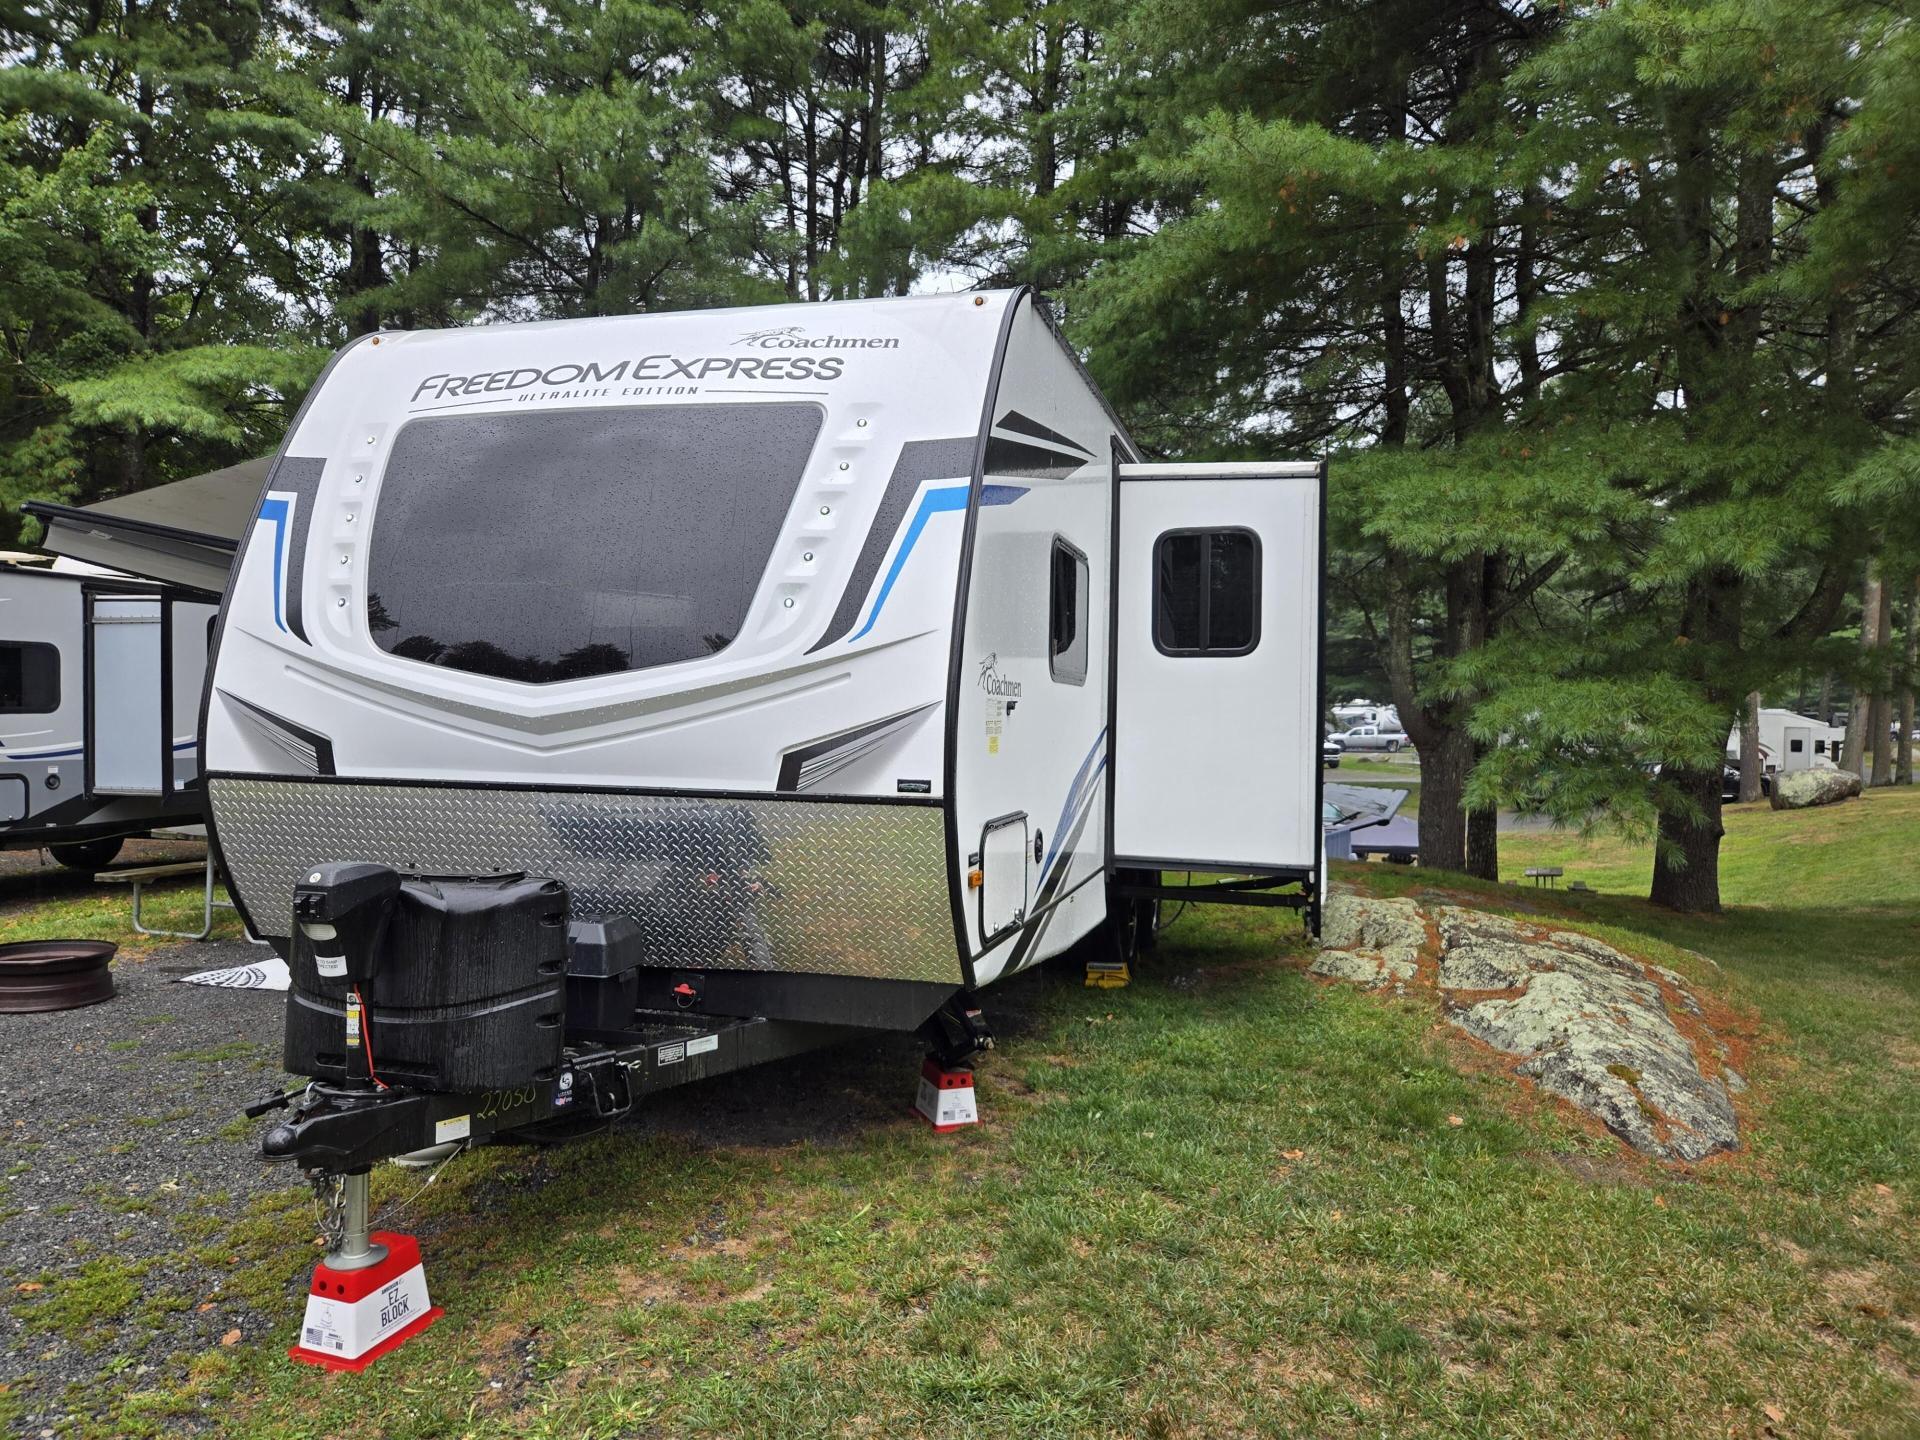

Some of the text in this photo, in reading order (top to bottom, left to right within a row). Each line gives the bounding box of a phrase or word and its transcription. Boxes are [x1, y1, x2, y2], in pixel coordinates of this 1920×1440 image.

[760, 335, 899, 349] Coachmen
[518, 386, 699, 402] ULTRALITE EDITION
[986, 674, 1022, 698] Coachmen
[388, 1287, 399, 1306] EZ
[381, 1297, 410, 1328] BLOCK
